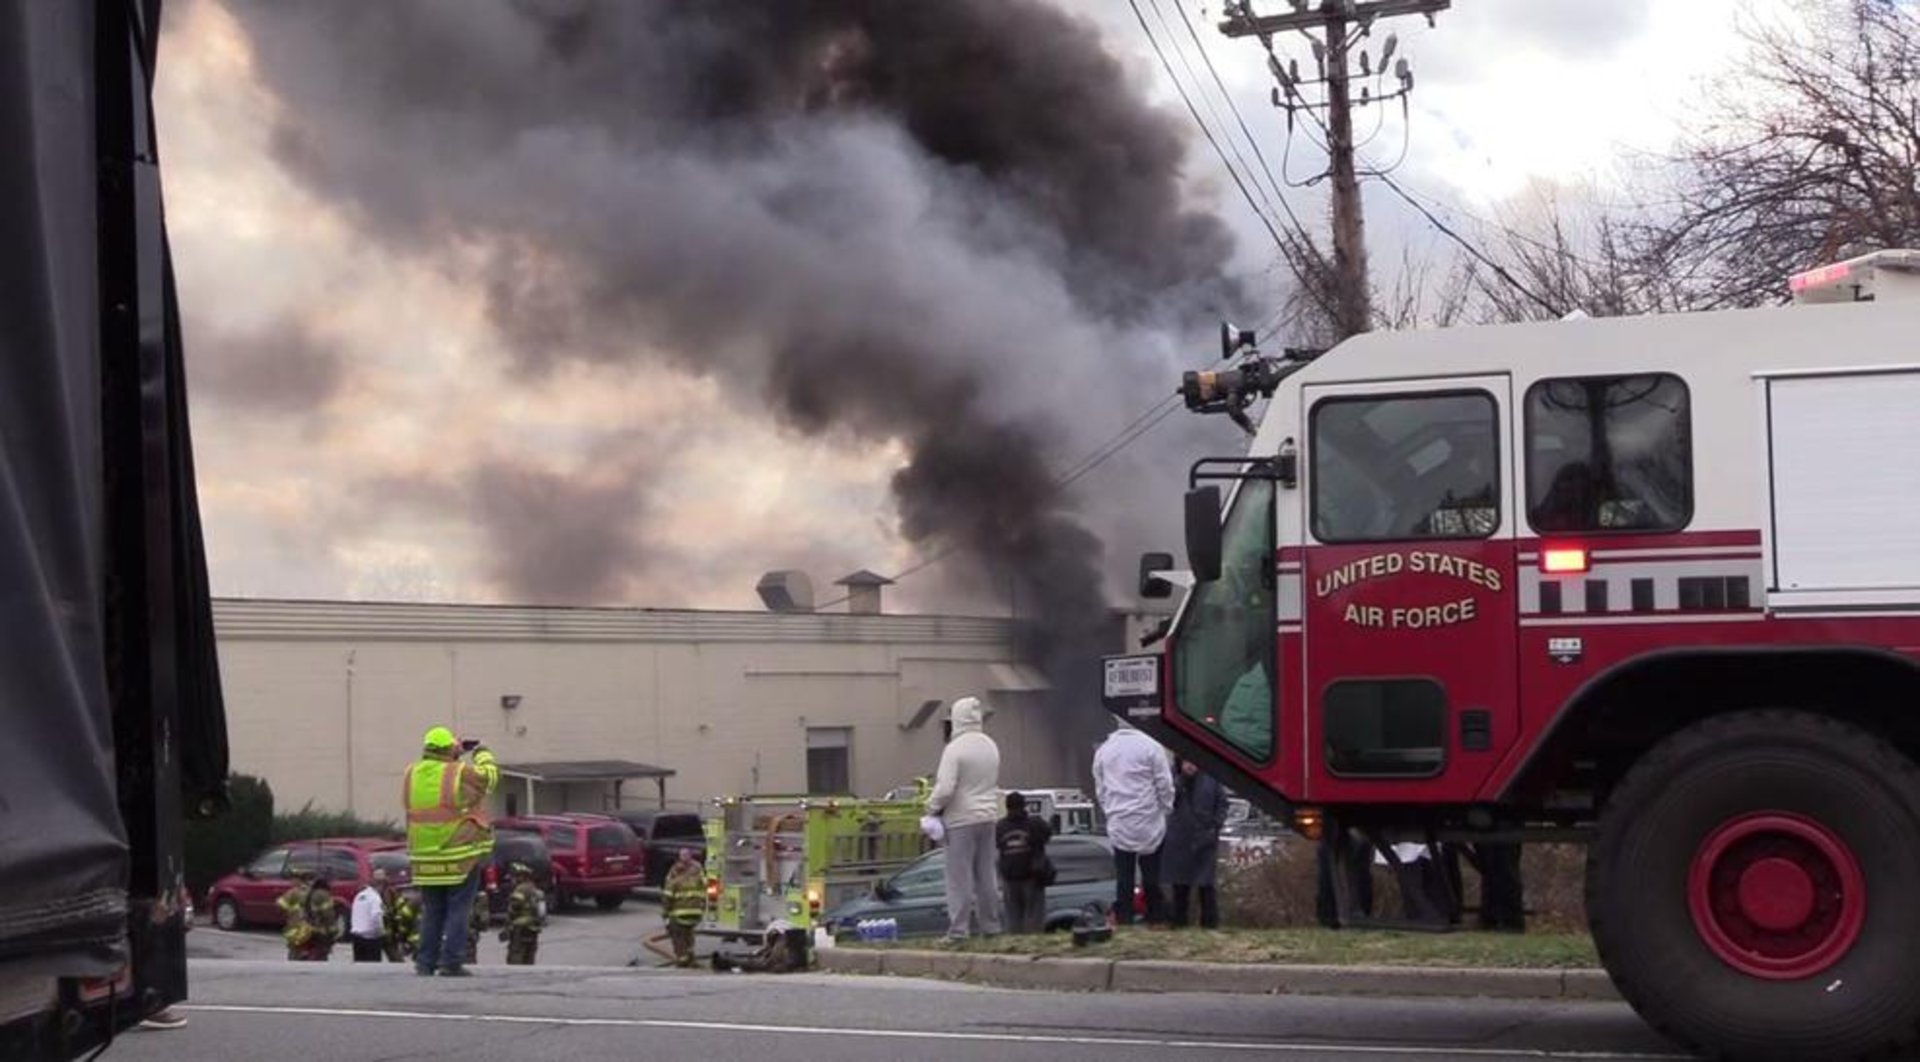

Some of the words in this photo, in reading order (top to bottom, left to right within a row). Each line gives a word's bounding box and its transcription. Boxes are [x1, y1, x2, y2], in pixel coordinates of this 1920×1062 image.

[1316, 552, 1403, 597] UNITED
[1409, 551, 1501, 591] STATES
[1344, 603, 1384, 628] AIR
[1391, 598, 1475, 628] FORCE
